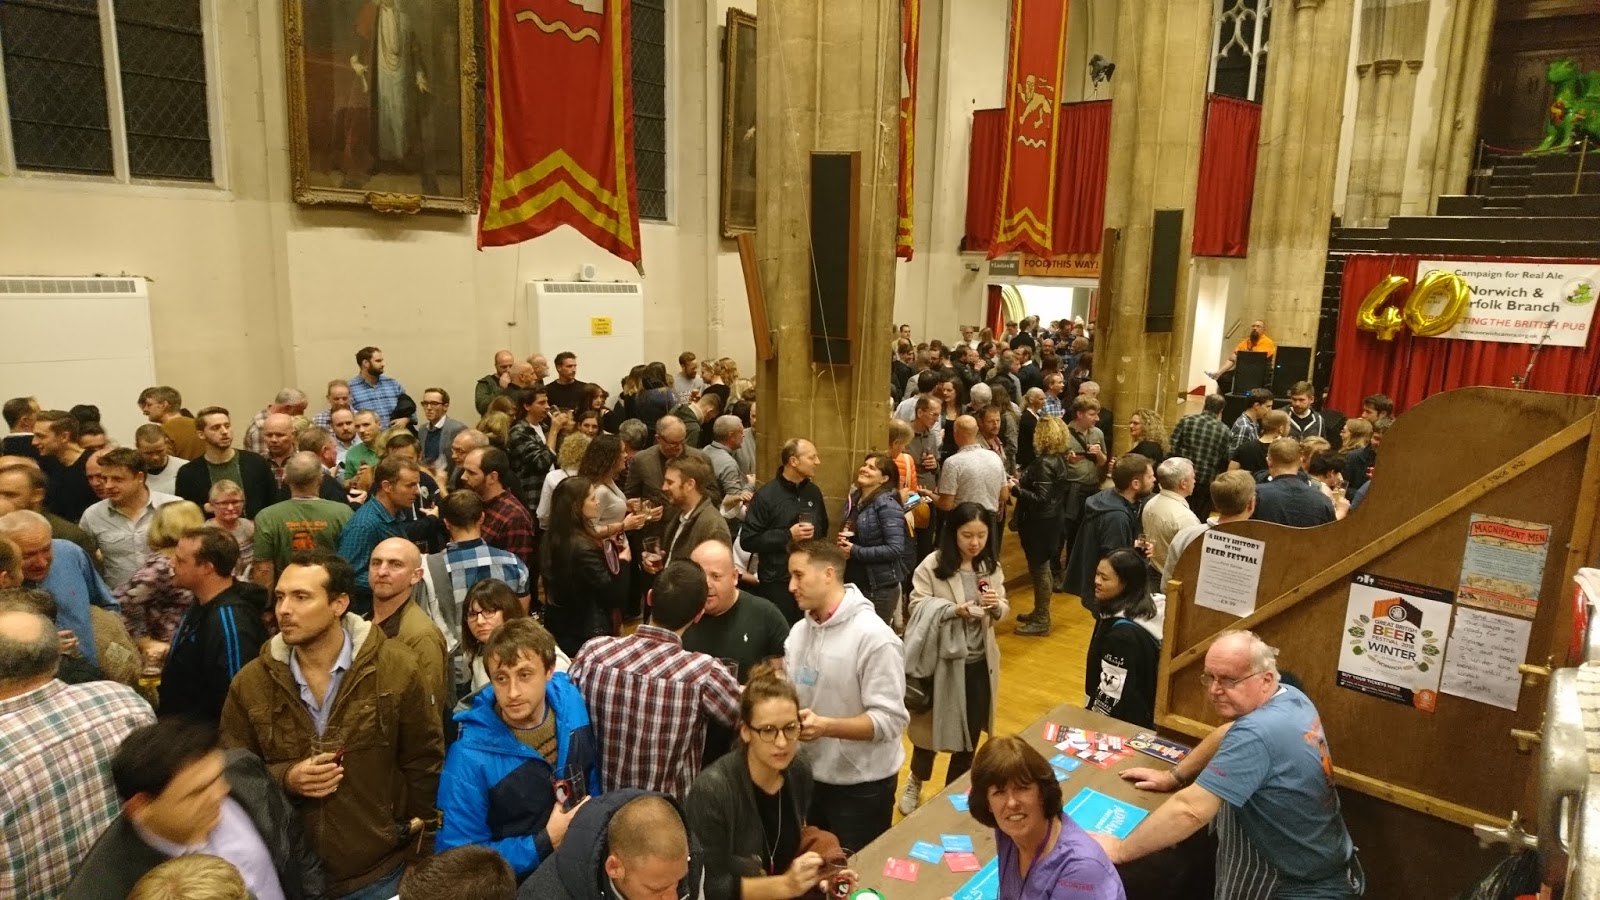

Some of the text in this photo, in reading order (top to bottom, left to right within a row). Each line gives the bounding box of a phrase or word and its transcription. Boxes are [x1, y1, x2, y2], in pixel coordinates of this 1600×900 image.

[1024, 260, 1099, 269] FOOD THIS WAY!
[1454, 270, 1502, 279] Campaign
[1505, 270, 1520, 278] for
[1468, 285, 1544, 298] Norwich &
[1469, 299, 1560, 312] rfolk Branch
[1490, 318, 1512, 327] THE
[1514, 320, 1559, 329] BRITISH
[1562, 322, 1586, 331] PUB
[1474, 525, 1545, 542] MAGNIFICENT MEN
[1214, 534, 1231, 543] HAZY
[1232, 539, 1260, 549] HISTORY
[1206, 547, 1258, 565] BEER FESTIAL
[1373, 625, 1416, 644] BEER
[1396, 624, 1417, 633] BRITISH
[1372, 635, 1398, 645] FESTIVAL
[1368, 641, 1416, 661] WINTER
[1367, 678, 1386, 687] TICKETS
[1102, 804, 1126, 834] ADNAM
